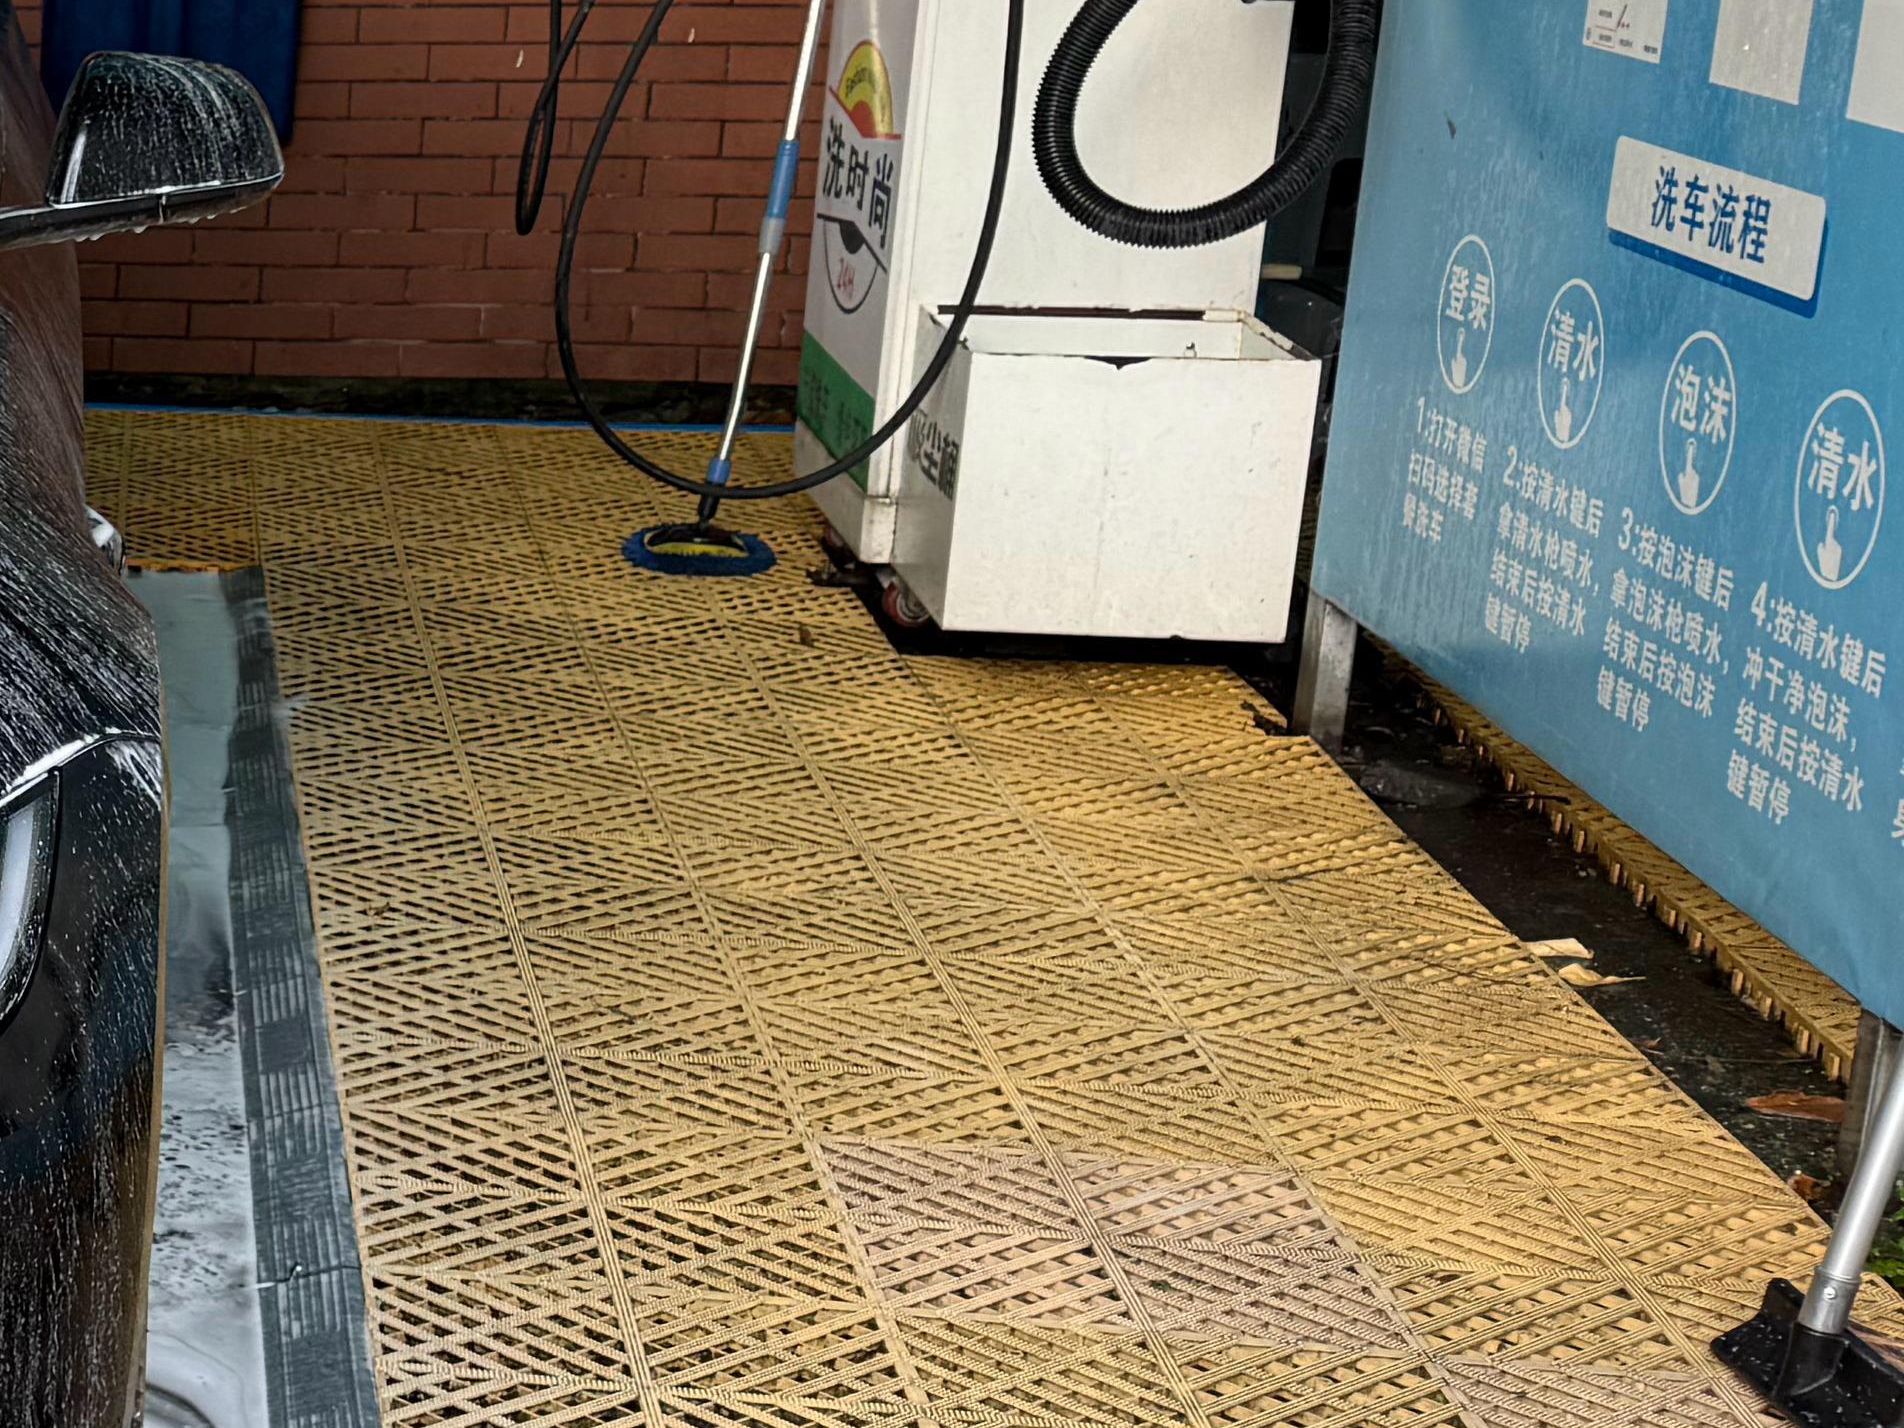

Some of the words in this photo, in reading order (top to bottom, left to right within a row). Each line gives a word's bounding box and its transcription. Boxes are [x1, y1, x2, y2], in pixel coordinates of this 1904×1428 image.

[823, 118, 894, 250] 洗时尚
[1651, 165, 1771, 264] 洗车流程
[1446, 264, 1490, 331] 登录
[1548, 308, 1599, 381] 清水
[1672, 364, 1731, 444] 泡沫
[1808, 422, 1877, 510] 清水
[1485, 592, 1531, 653] 键暂停
[1491, 548, 1585, 636] 结束后按清水
[1598, 665, 1650, 732] 键暂停
[1603, 617, 1715, 718] 结束后按泡沫
[1727, 749, 1791, 825] 键暂停
[1734, 697, 1864, 812] 结束后按清水
